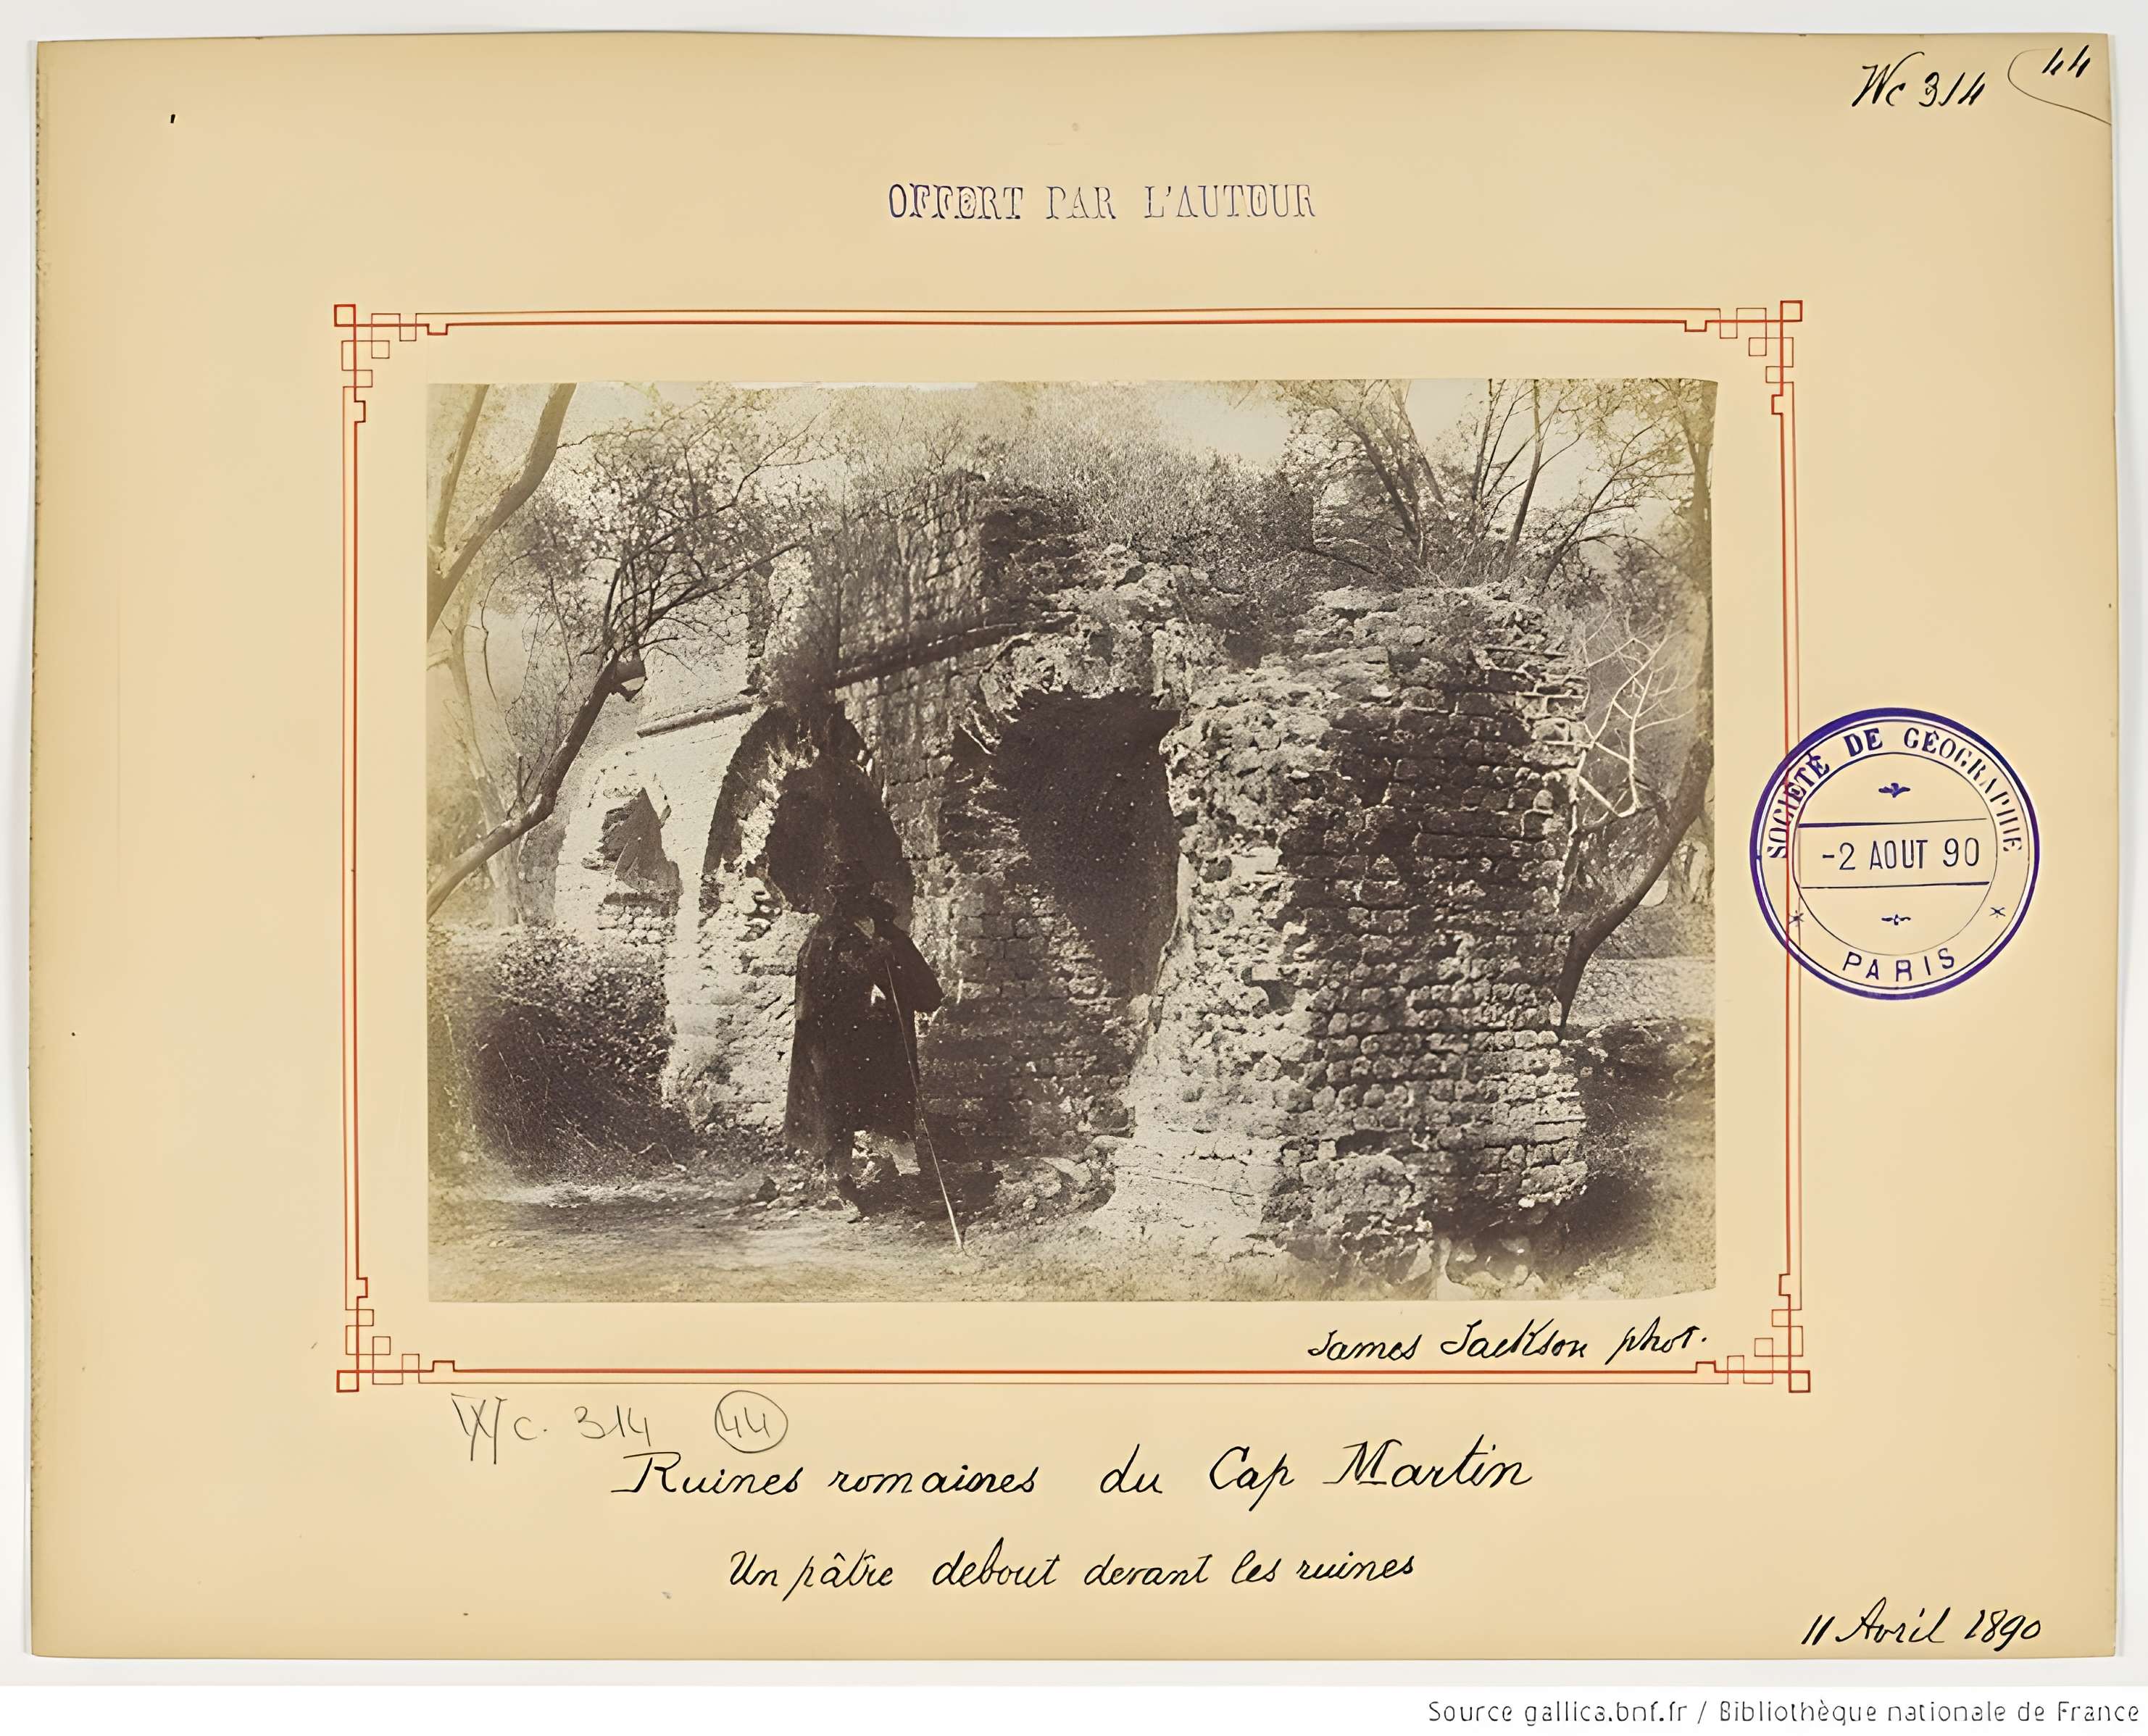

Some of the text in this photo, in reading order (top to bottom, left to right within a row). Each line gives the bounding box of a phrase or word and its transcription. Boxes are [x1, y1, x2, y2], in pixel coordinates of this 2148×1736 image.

[889, 183, 1315, 220] OFFERT PAR L'AUTEUR
[1843, 727, 1883, 758] DE
[1870, 840, 1928, 869] AOUT
[1943, 838, 1979, 867] 90
[1842, 947, 1955, 982] PARIS
[1307, 1330, 1423, 1361] James
[1440, 1318, 1588, 1359] Jackson
[575, 1405, 651, 1447] 314
[722, 1407, 770, 1440] 44
[611, 1434, 1533, 1511] Ruines romaines du Cap Martin
[730, 1537, 1415, 1602] Un pâtre debout devant les ruines
[1835, 1597, 1951, 1643] Avril
[1964, 1609, 2041, 1652] 1890
